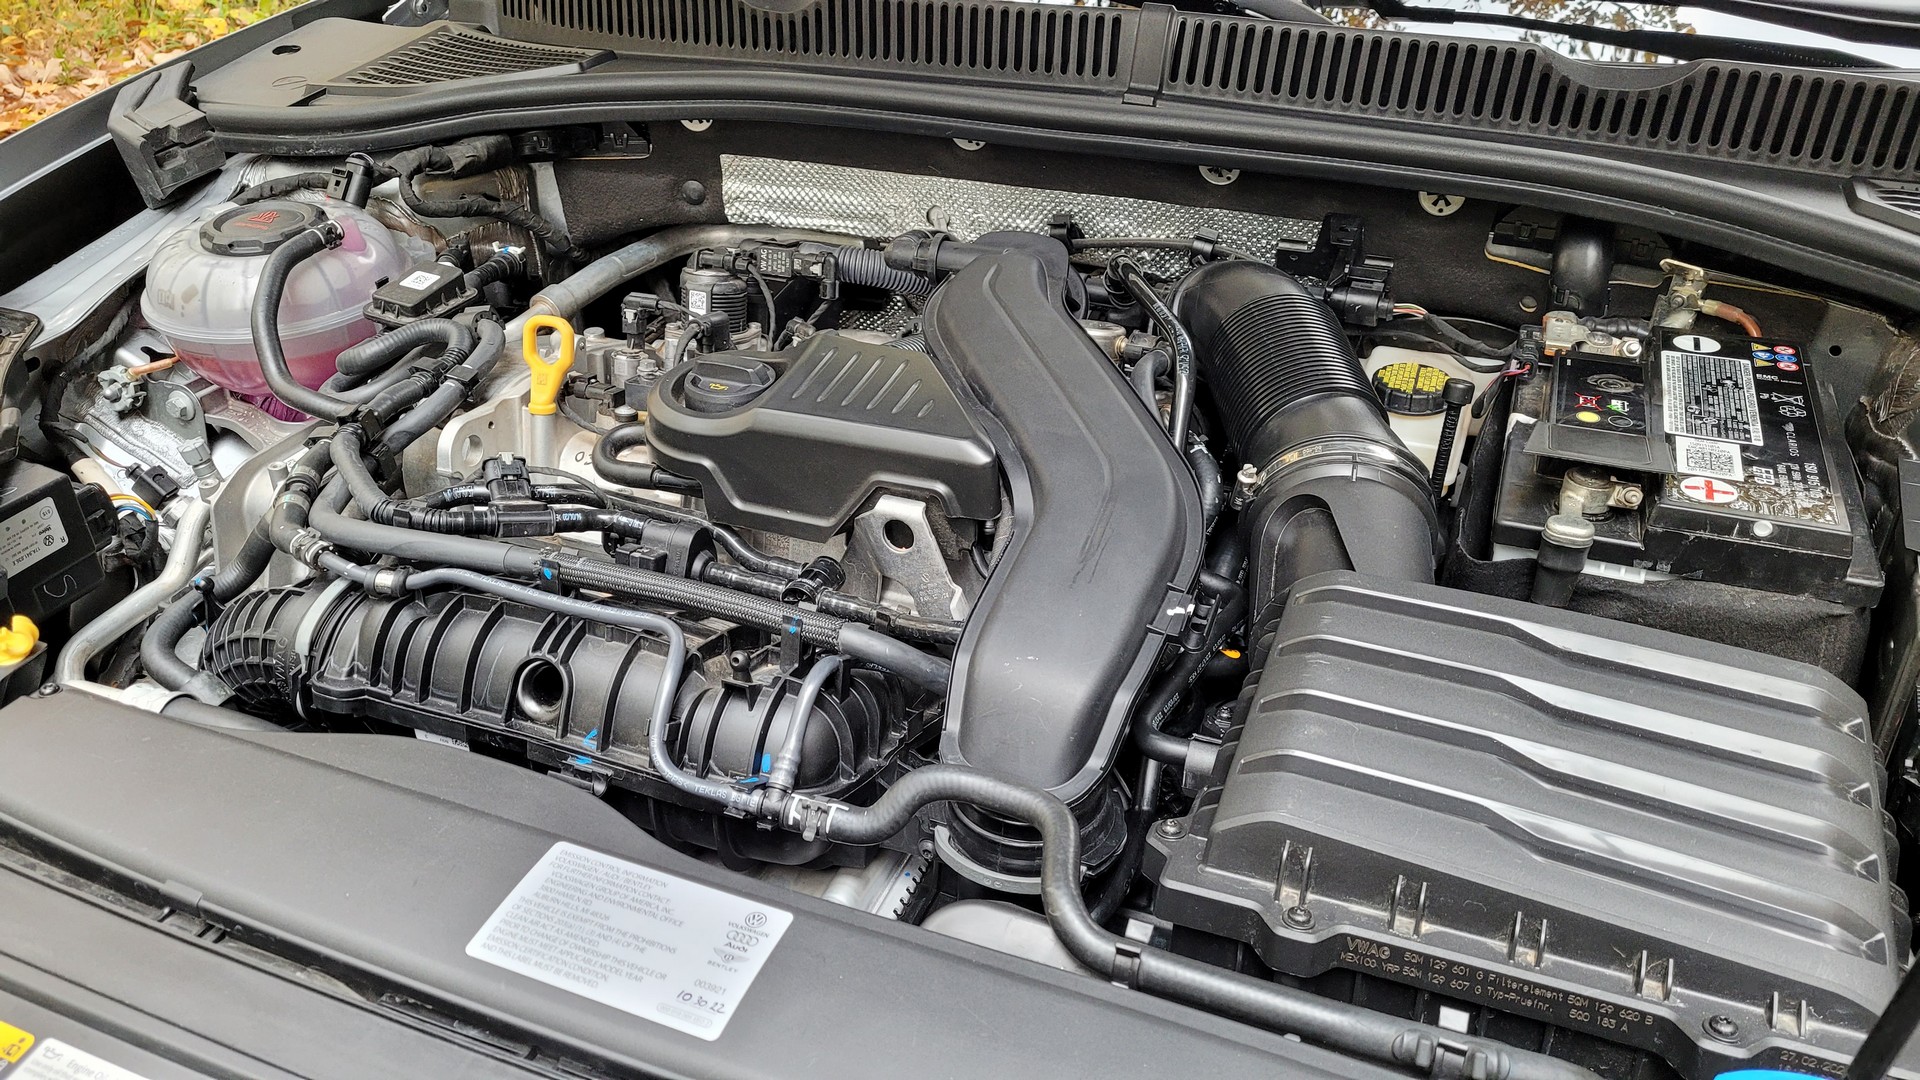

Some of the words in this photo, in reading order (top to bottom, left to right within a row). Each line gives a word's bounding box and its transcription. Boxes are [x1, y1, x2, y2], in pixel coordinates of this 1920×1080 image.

[1785, 431, 1799, 457] CLARIOS
[1752, 465, 1775, 486] EFB
[1807, 474, 1821, 487] 915
[694, 785, 728, 799] TEKLAS
[554, 855, 598, 873] VOLKSWAGEN
[603, 870, 619, 880] AUDI
[623, 876, 651, 890] BENTLEY
[559, 849, 590, 863] EMISSION
[590, 858, 621, 872] CONTROL
[622, 868, 668, 887] INFORMATION
[550, 870, 595, 889] VOLKSWAGEN
[728, 922, 769, 938] VOLKSWAGEN
[725, 942, 748, 953] Audi
[707, 960, 737, 974] BENTLEY
[676, 990, 692, 1001] 10
[1404, 952, 1424, 964] 5QM
[1430, 958, 1448, 970] 129
[1452, 964, 1470, 976] 601
[1476, 971, 1484, 980] G
[1488, 969, 1563, 1002] Filterelement
[1567, 994, 1589, 1008] 5QM
[1595, 1002, 1614, 1014] 129
[1619, 1009, 1640, 1022] 620
[1644, 1015, 1653, 1025] B
[1402, 966, 1422, 978] 5QM
[1428, 972, 1446, 984] 129
[1450, 979, 1470, 991] 607
[1474, 985, 1482, 994] G
[1487, 986, 1553, 1012] Typ-Pruefnr.
[1597, 1016, 1616, 1029] 183
[1620, 1022, 1628, 1033] A
[1779, 1049, 1848, 1076] 27.02.202
